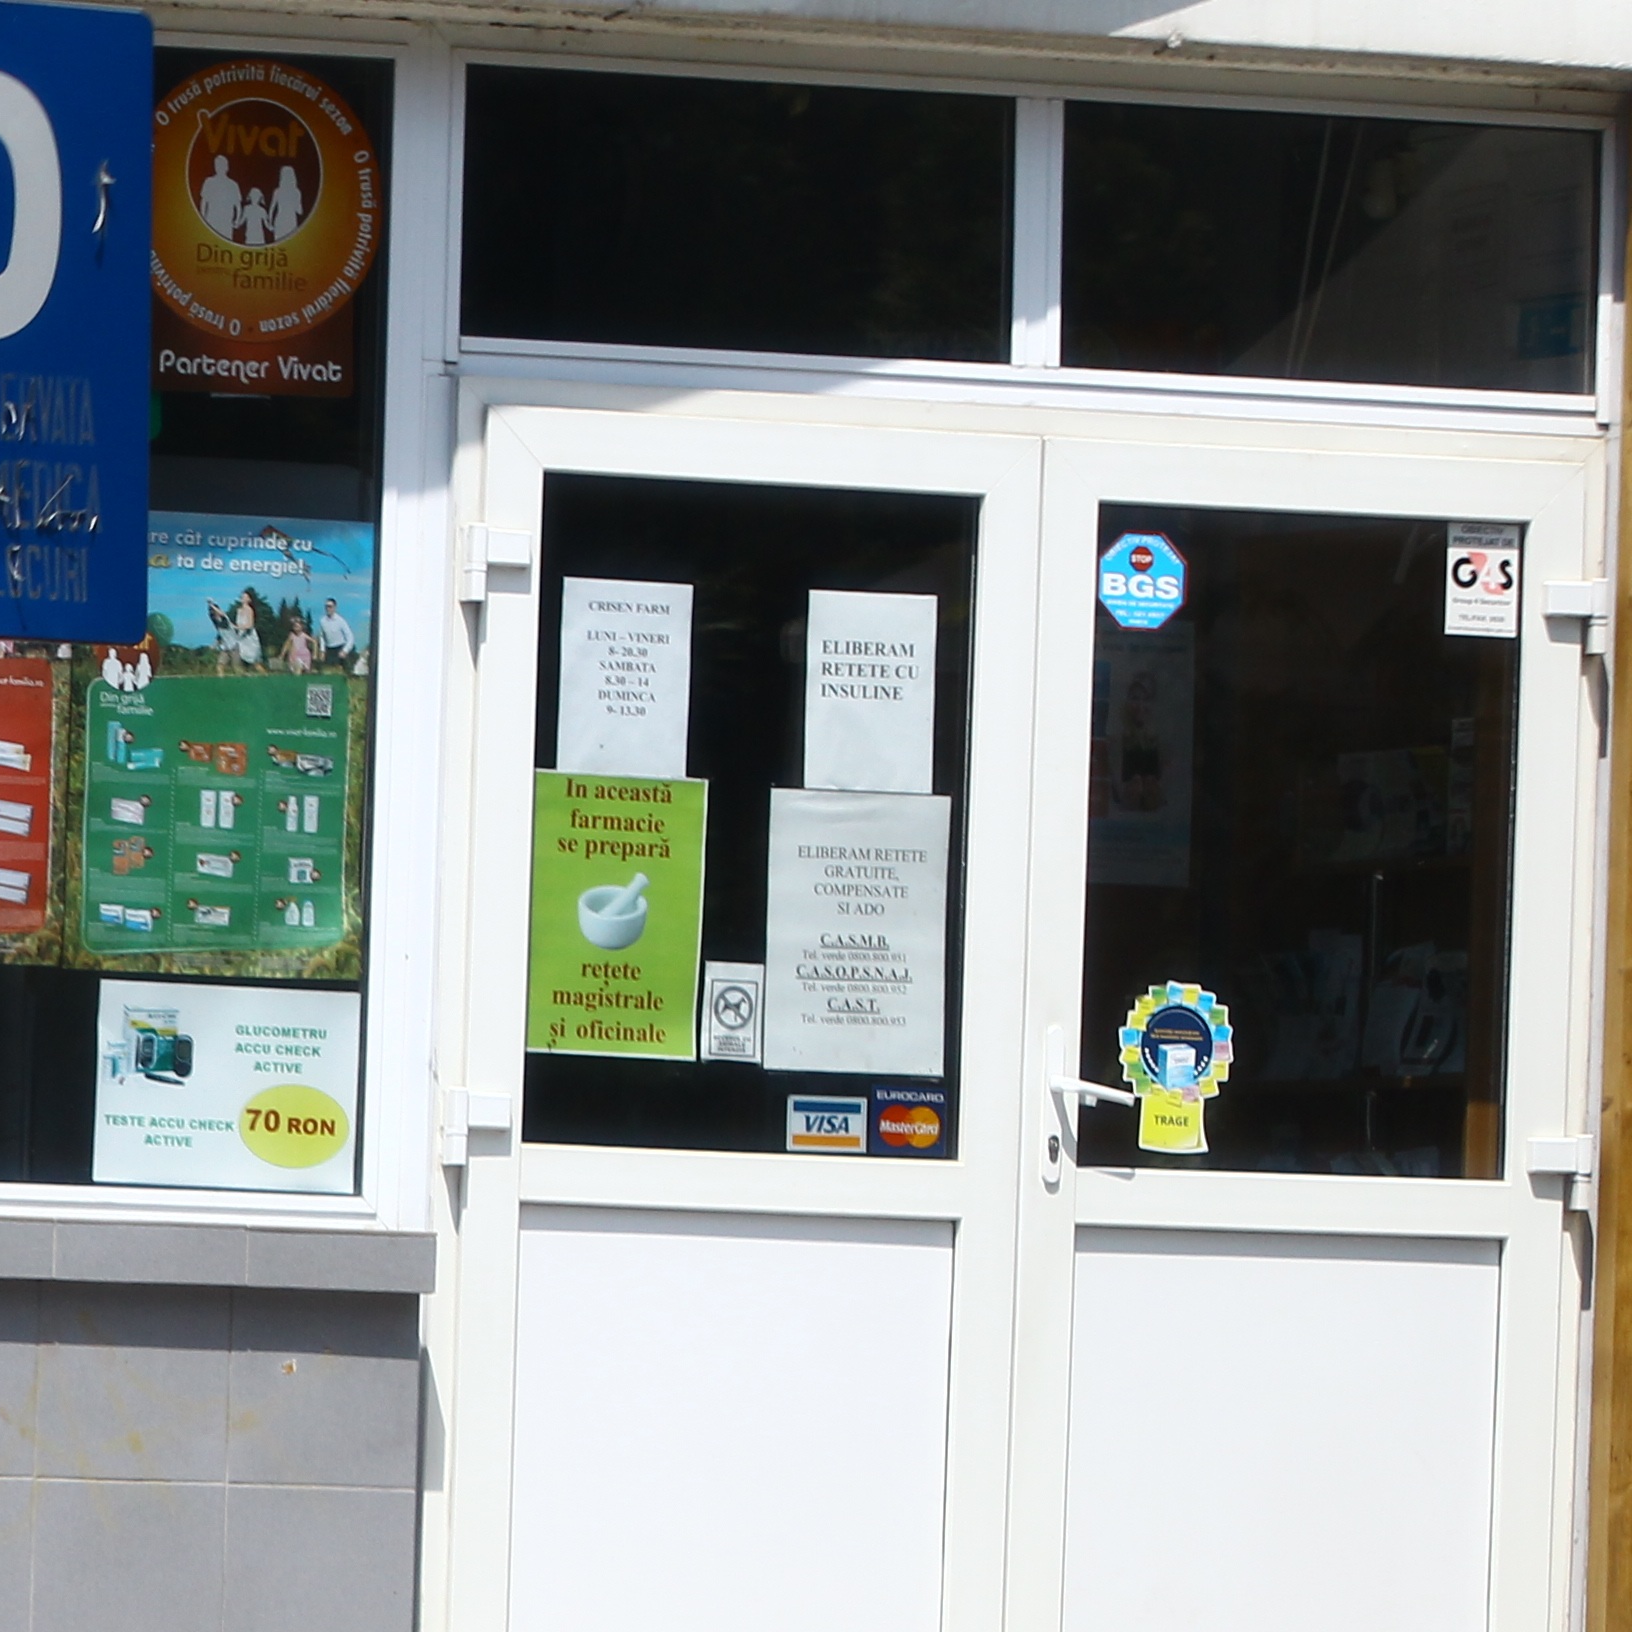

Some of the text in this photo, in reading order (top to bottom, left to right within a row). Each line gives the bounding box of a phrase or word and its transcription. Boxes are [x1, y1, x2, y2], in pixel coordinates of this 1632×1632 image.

[319, 97, 353, 136] sezon
[200, 112, 307, 158] Vivat
[196, 243, 288, 269] Din grijă
[232, 269, 307, 292] familie
[159, 349, 342, 384] Partener Vivat
[175, 529, 202, 545] cât
[208, 531, 288, 552] cuprinde
[293, 538, 313, 551] cu
[176, 553, 195, 569] ta
[201, 552, 224, 570] de
[1102, 572, 1180, 600] BGS
[636, 603, 670, 615] FARM
[587, 630, 670, 645] LUNI VINERI
[822, 640, 914, 658] ELIBERAM
[599, 661, 656, 673] SAMBATA
[821, 662, 919, 680] RETETE CU
[821, 683, 904, 700] INSULINE
[594, 783, 673, 804] această
[570, 809, 665, 834] farmacie
[557, 837, 671, 862] se prepară
[798, 845, 927, 862] ELIBERAM RETETE
[814, 883, 909, 898] COMPENSATE
[837, 902, 885, 916] SI ADO
[581, 961, 641, 988] rețete
[552, 987, 664, 1012] magistrale
[235, 1024, 328, 1040] GLUCOMETRU
[576, 1019, 666, 1044] oficinale
[235, 1042, 322, 1058] ACCU CHECK
[253, 1061, 304, 1074] ACTIVE
[876, 1089, 944, 1103] EUROCARD
[104, 1114, 235, 1132] TESTE ACCU CHECK
[245, 1108, 337, 1136] 70 RON
[804, 1114, 850, 1134] VISA
[879, 1118, 939, 1135] MasterCard
[1154, 1114, 1189, 1128] TRAGE
[144, 1134, 193, 1148] ACTIVE
